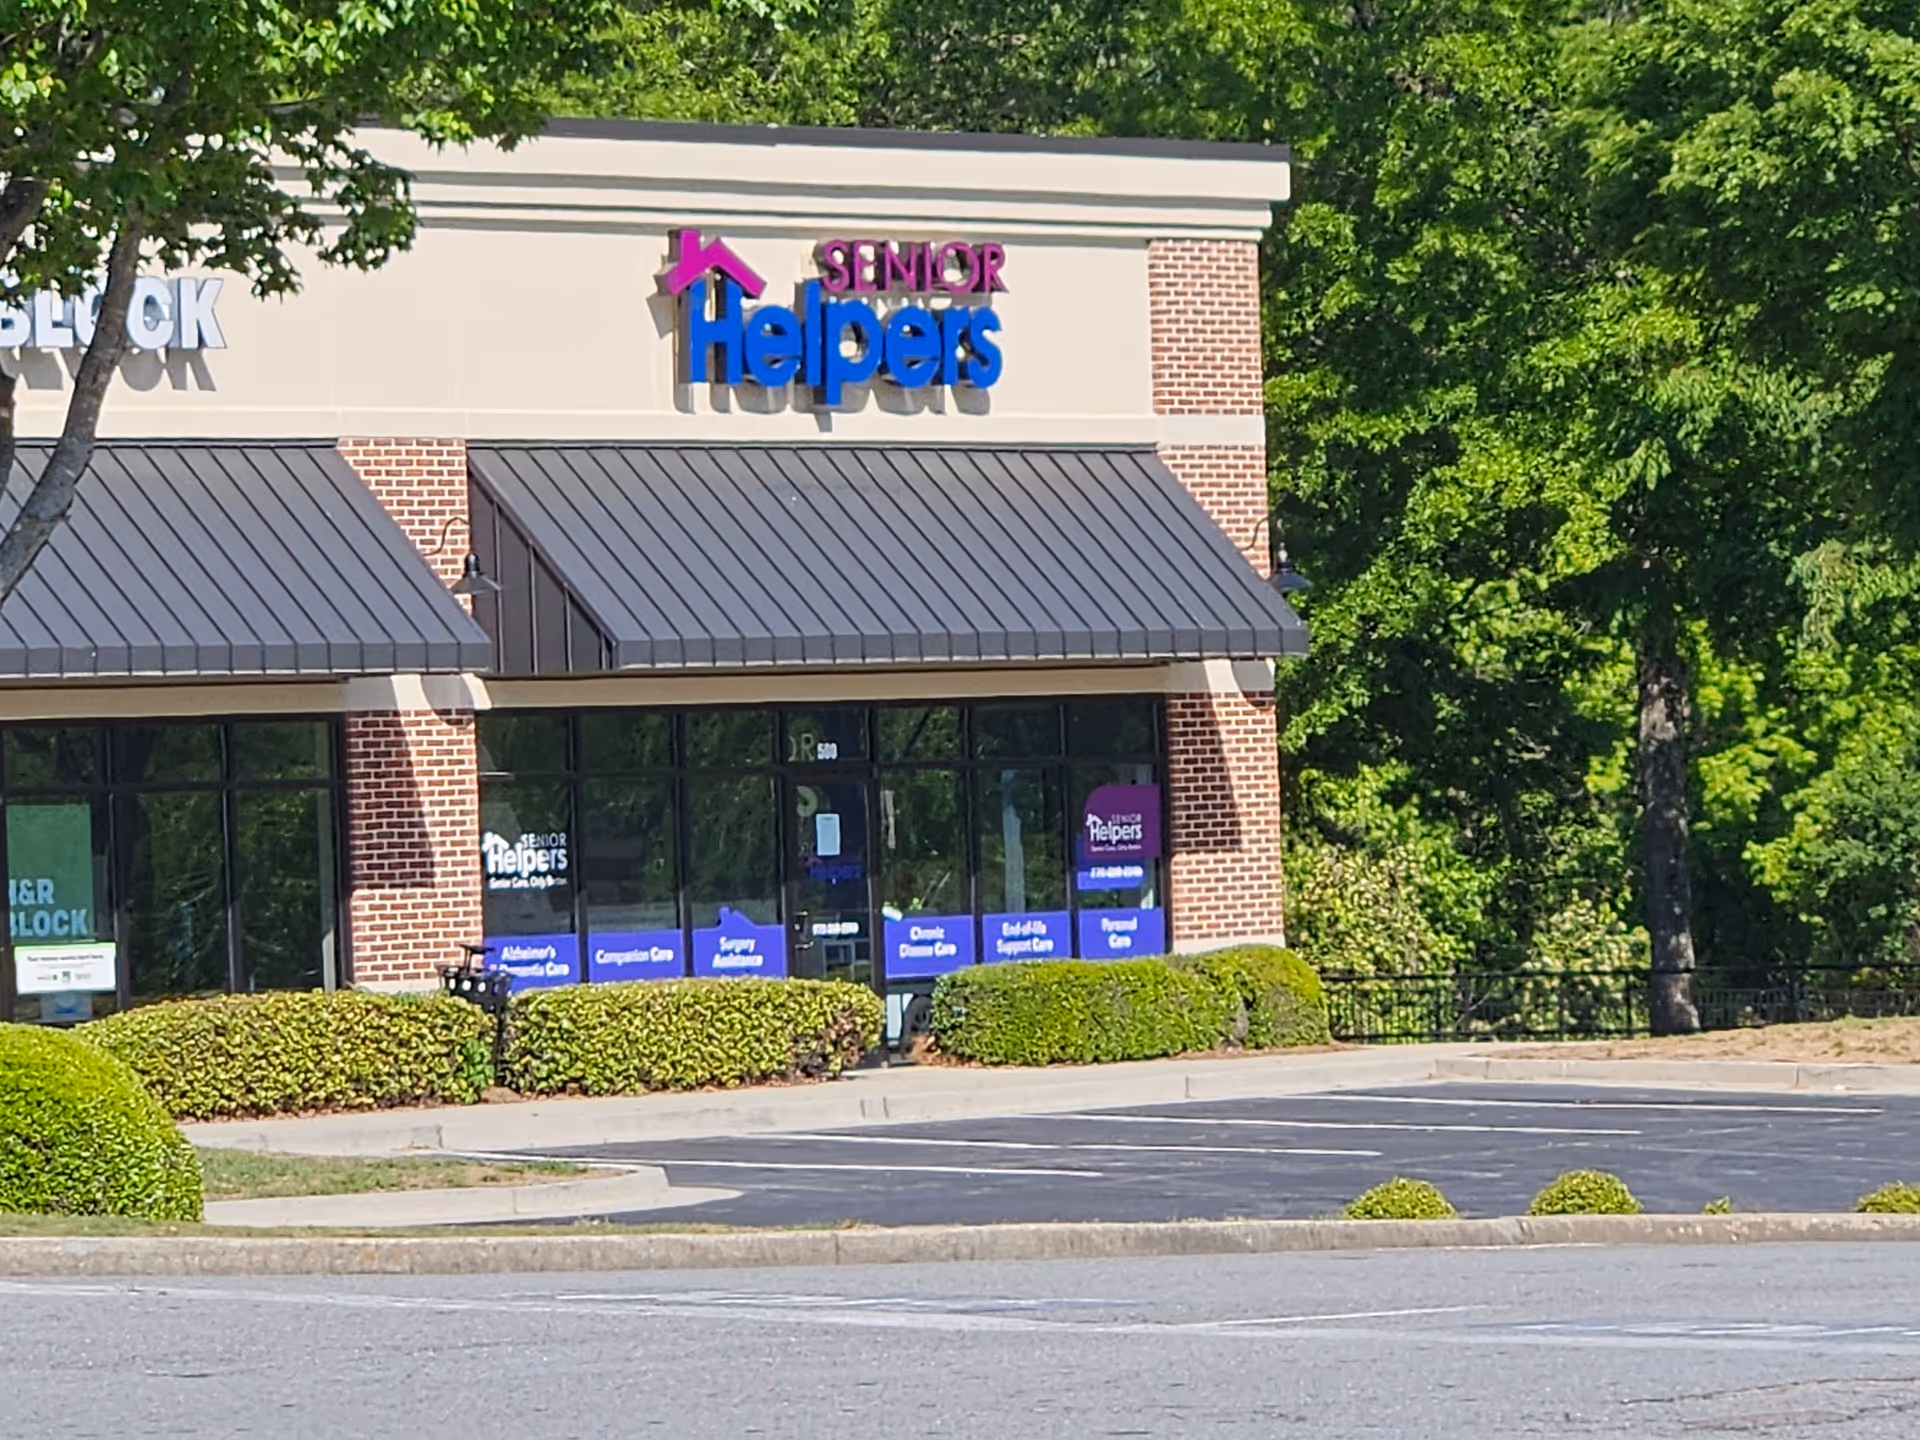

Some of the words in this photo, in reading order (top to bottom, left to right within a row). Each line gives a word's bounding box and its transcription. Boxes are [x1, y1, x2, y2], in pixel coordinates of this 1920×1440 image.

[822, 239, 1007, 294] SENIOR
[689, 277, 1003, 405] Helpers
[520, 832, 567, 848] SENIOR
[1089, 820, 1143, 845] Helpers
[487, 842, 568, 878] Helpers
